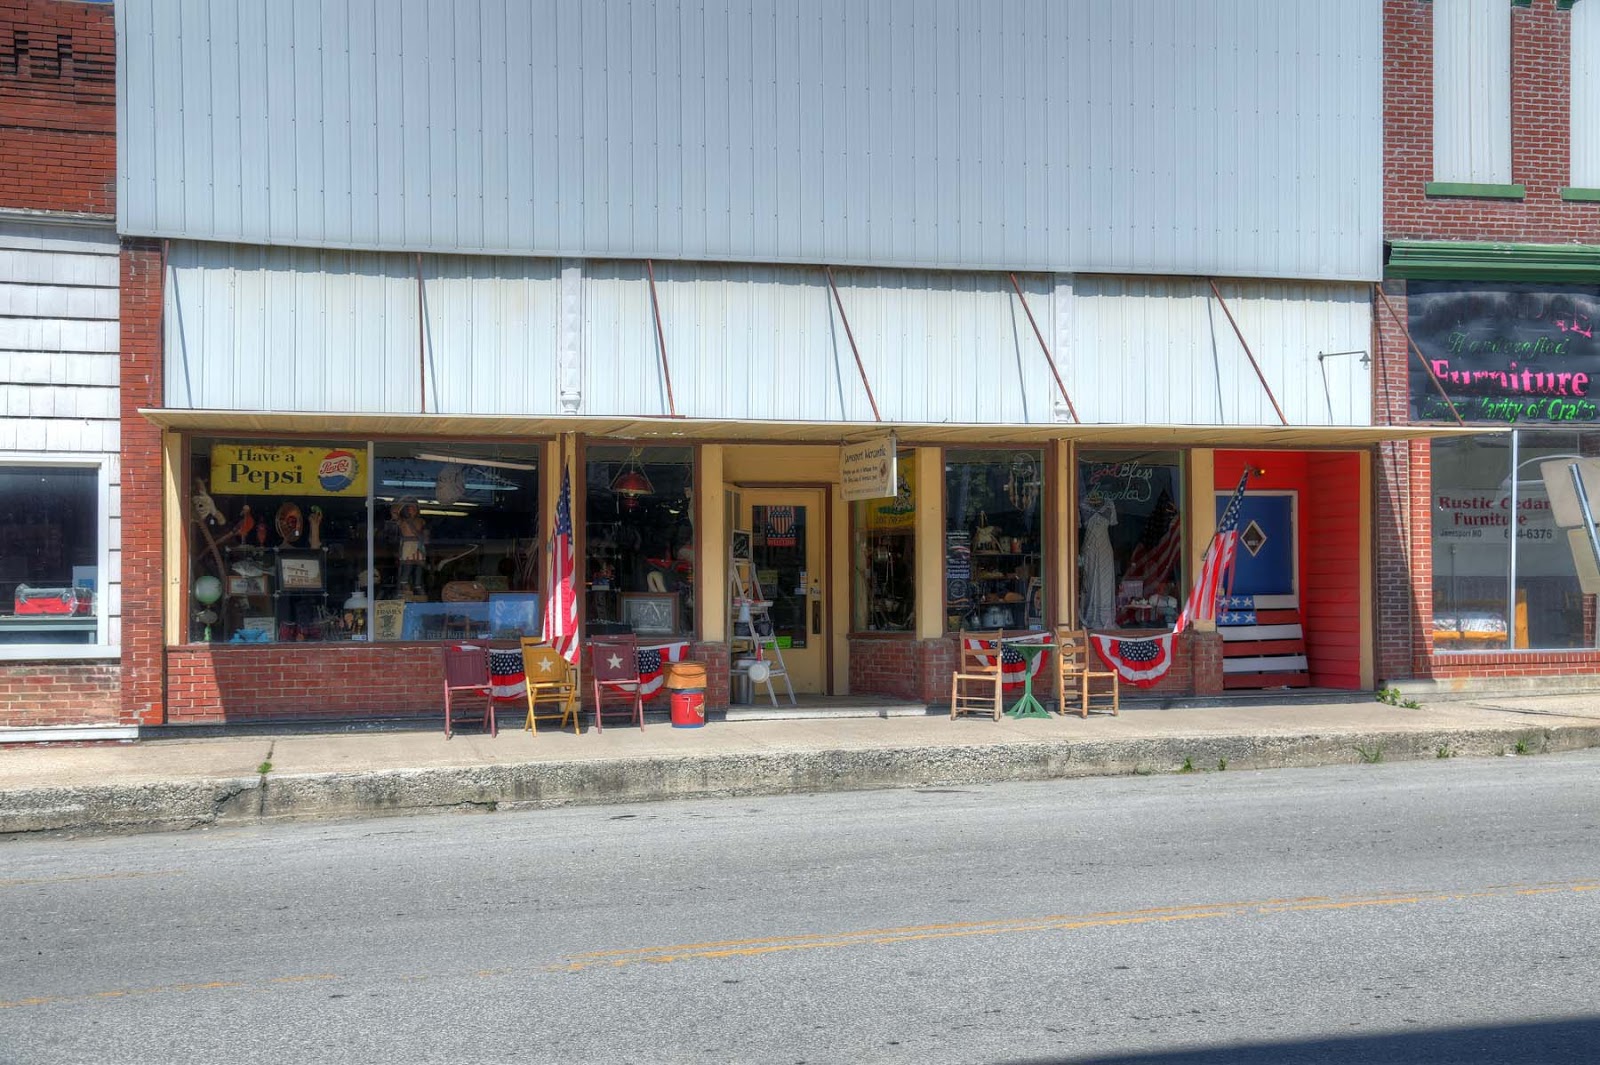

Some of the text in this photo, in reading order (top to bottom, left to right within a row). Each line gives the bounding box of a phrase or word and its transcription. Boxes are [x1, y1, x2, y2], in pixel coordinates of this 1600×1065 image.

[1431, 360, 1589, 395] Furniture
[1547, 398, 1596, 420] Crafts
[237, 448, 295, 463] Have a
[227, 464, 305, 490] Pepsi
[1120, 461, 1152, 479] Bless
[1438, 496, 1494, 510] Rustic
[1454, 512, 1528, 526] Furnitue
